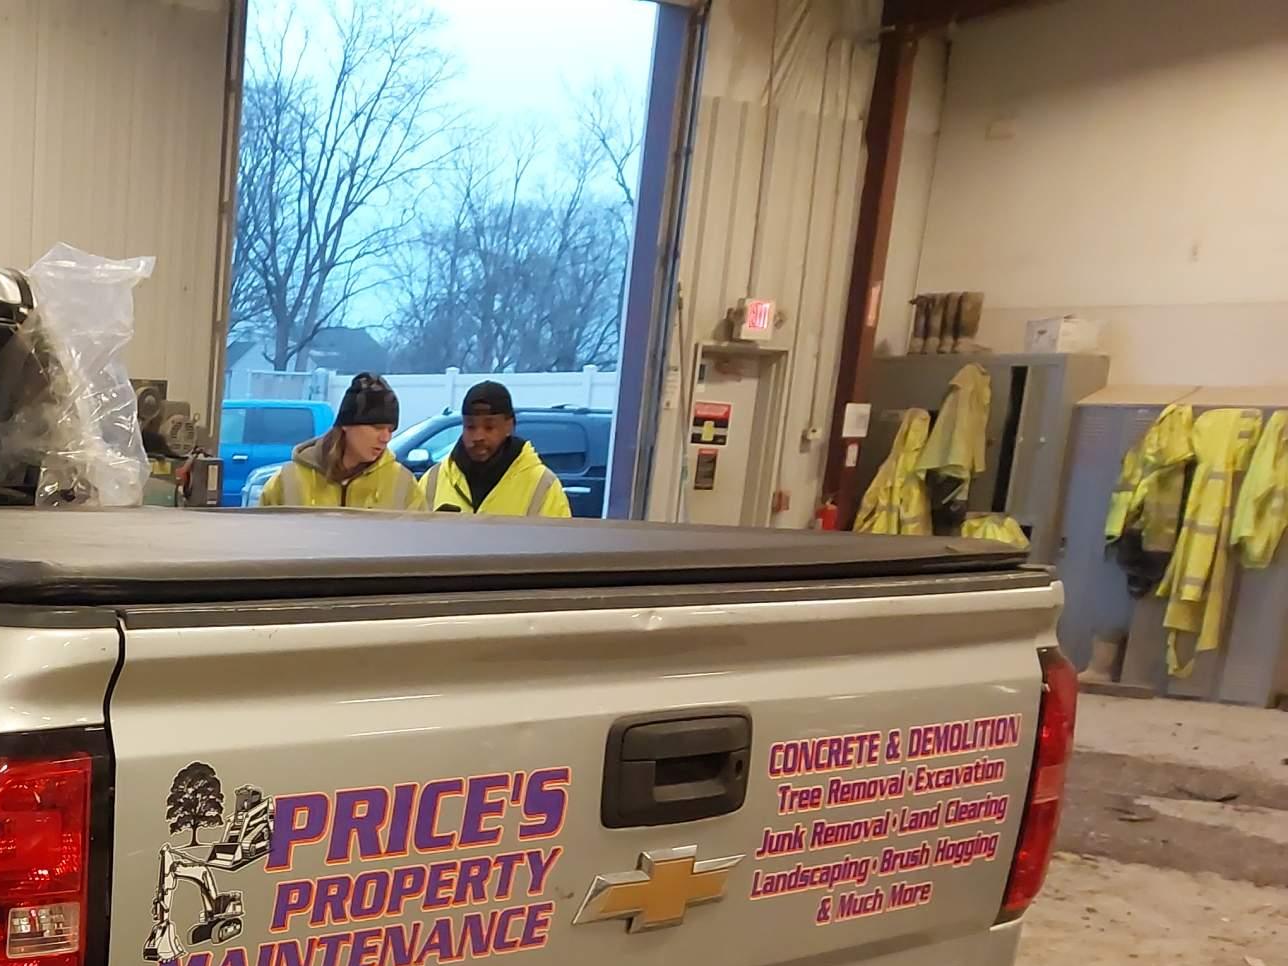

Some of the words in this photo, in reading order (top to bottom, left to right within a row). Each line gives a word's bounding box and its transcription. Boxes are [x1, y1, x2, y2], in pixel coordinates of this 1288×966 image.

[768, 731, 881, 777] CONCRETE
[885, 729, 901, 764] &
[907, 714, 1021, 759] DEMOLITION
[778, 784, 822, 814] Tree
[826, 769, 905, 807] Removal
[914, 758, 1005, 793] Excavation
[264, 767, 571, 872] PRICE'S
[755, 825, 806, 857] Junk
[810, 811, 890, 850] Removal
[899, 802, 941, 833] Land
[944, 794, 1008, 825] Clearing
[270, 846, 563, 932] PROPERTY
[750, 856, 870, 899] Landscaping
[879, 842, 930, 876] Brush
[934, 832, 1000, 868] Hogging
[815, 897, 831, 926] &
[835, 888, 884, 921] Much
[887, 882, 932, 911] More
